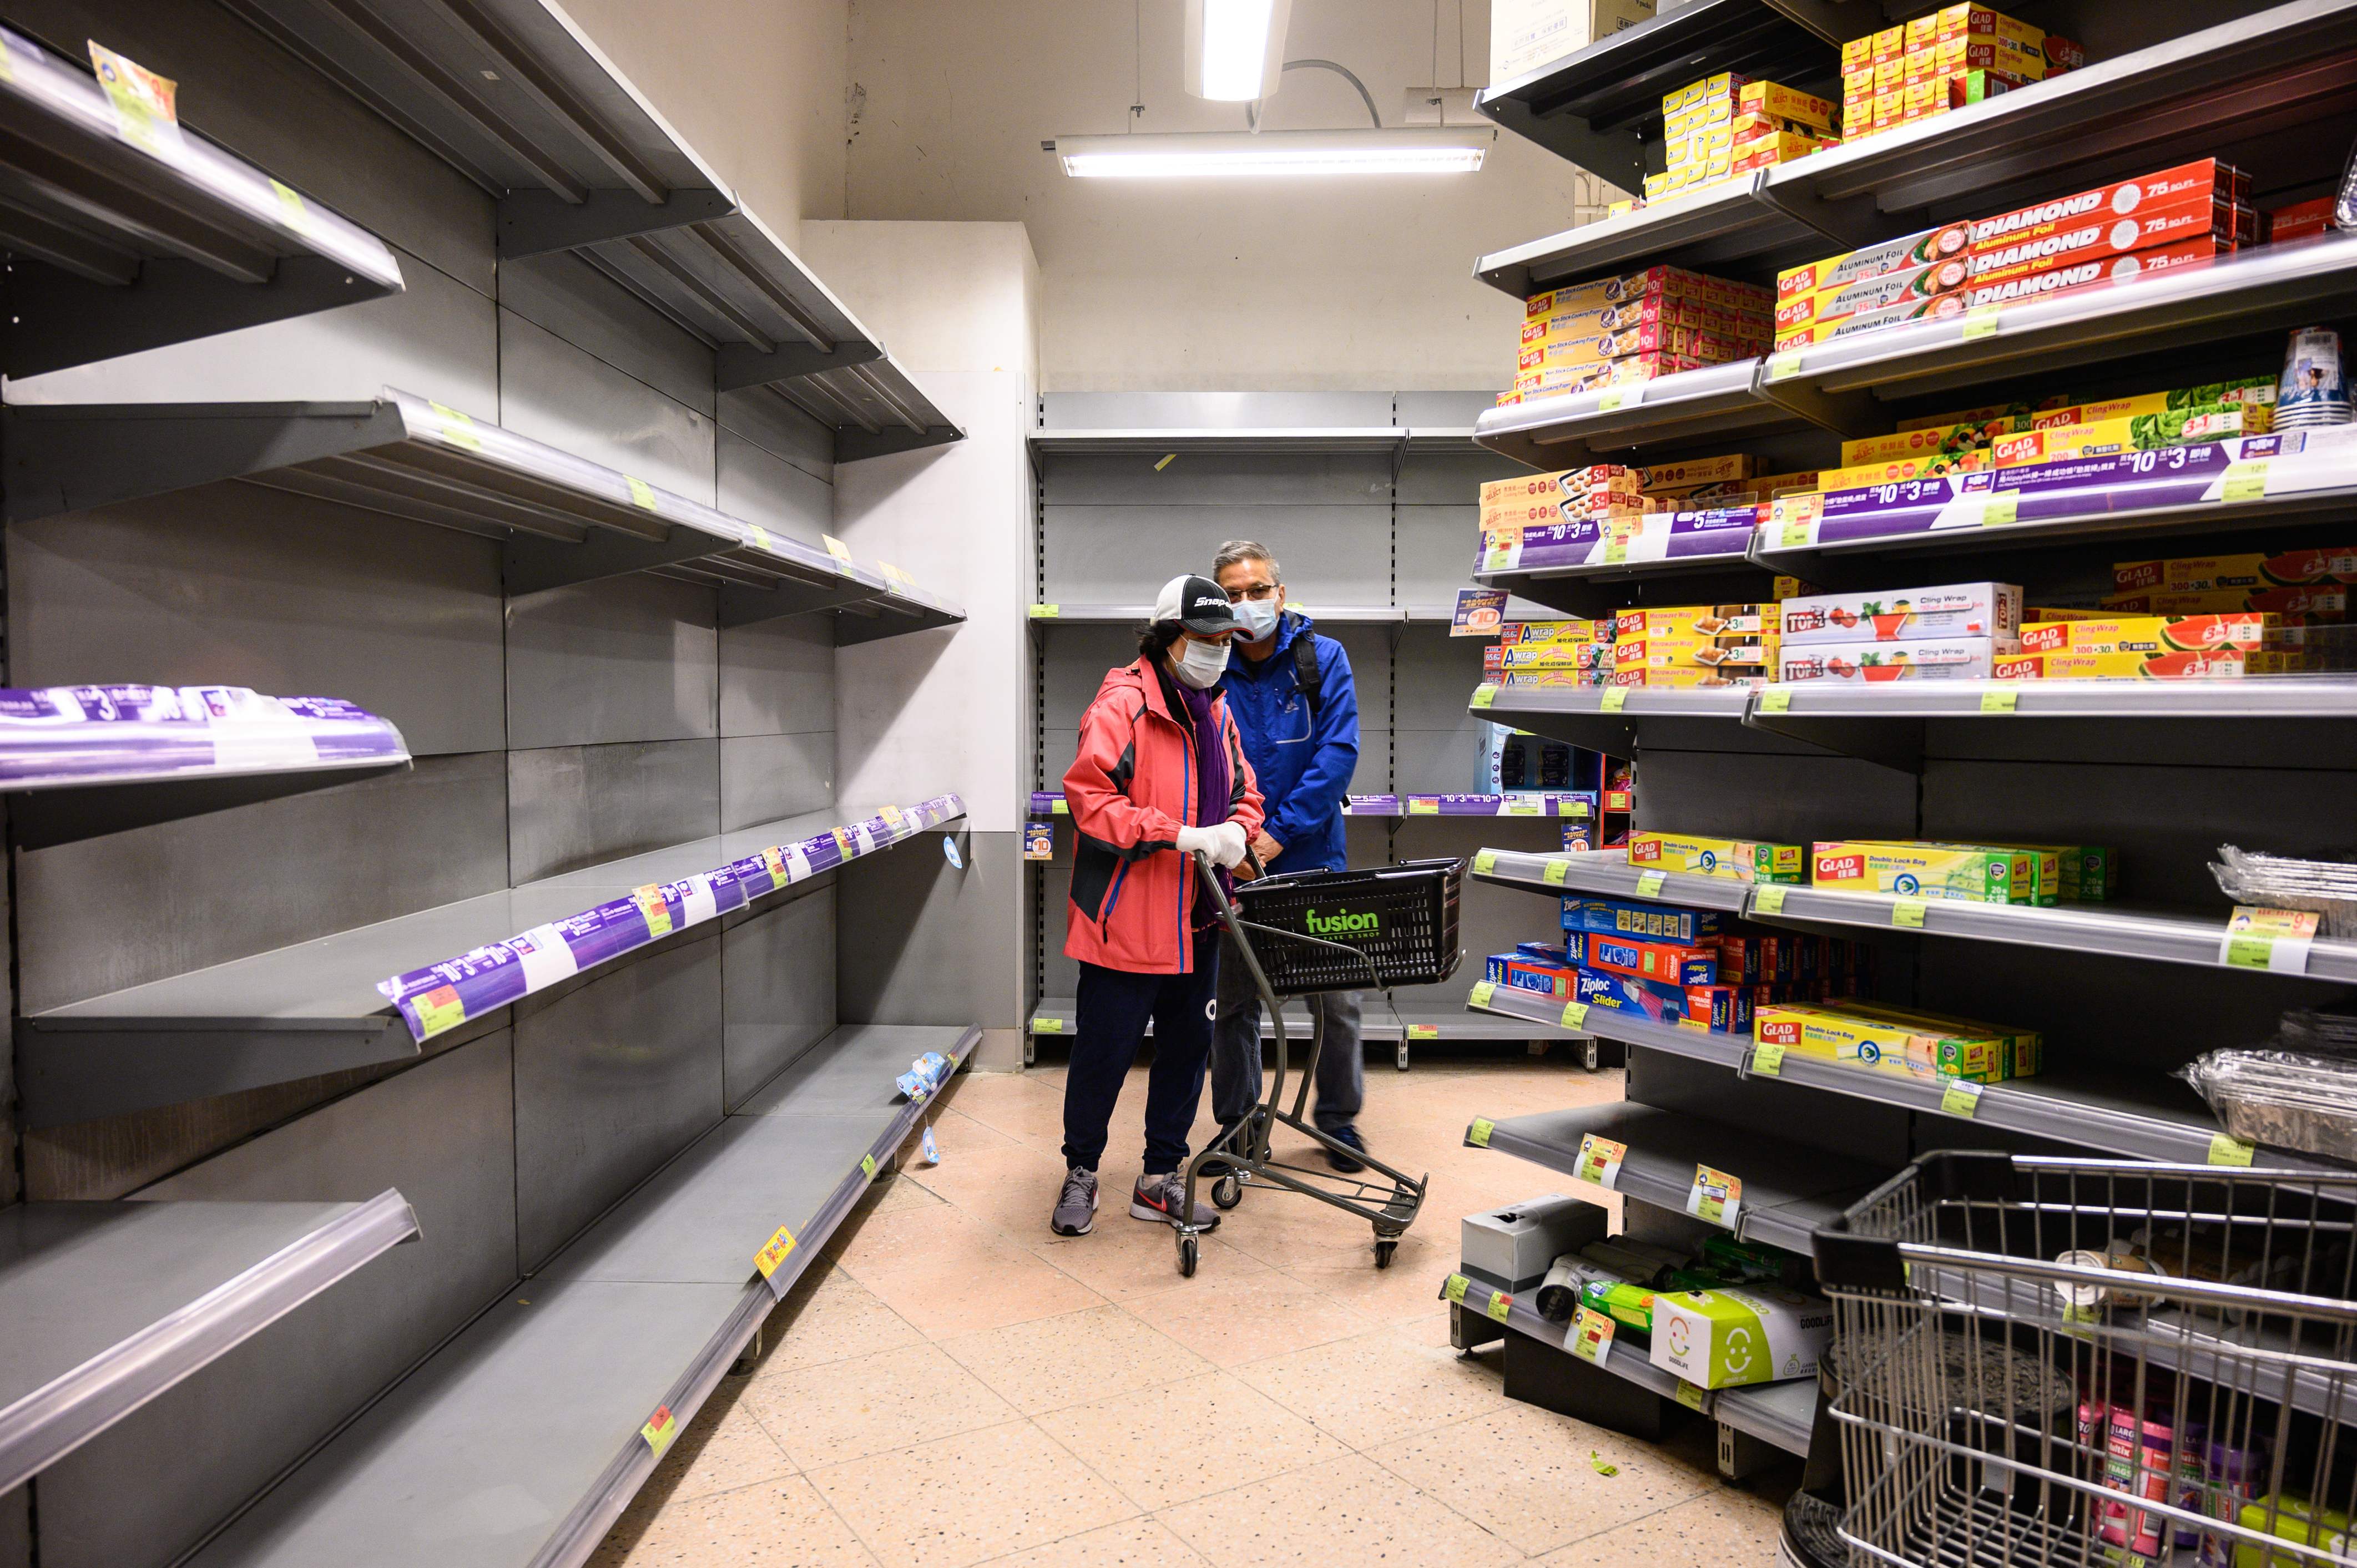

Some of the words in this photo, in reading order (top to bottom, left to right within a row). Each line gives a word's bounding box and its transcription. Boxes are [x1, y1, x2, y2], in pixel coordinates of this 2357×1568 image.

[1970, 12, 1991, 24] GLAD
[1969, 44, 1989, 57] GLAD
[1773, 95, 1788, 104] SELECT
[1786, 144, 1803, 153] SELECT
[2147, 180, 2168, 196] 75
[1975, 192, 2103, 240] DIAMOND
[2145, 217, 2167, 233] 75
[1975, 229, 2030, 251] Aluminum
[2032, 223, 2055, 237] Foil
[1975, 227, 2101, 273] DIAMOND
[1838, 255, 1883, 272] ALUMINUM
[1886, 249, 1904, 260] FOIL
[2147, 255, 2168, 270] 75
[1974, 264, 2030, 284] Aluminum
[2031, 257, 2053, 271] Foil
[1576, 284, 1592, 294] Cooking
[1593, 281, 1608, 290] Paper
[1781, 271, 1809, 291] GLAD
[1972, 264, 2101, 306] DIAMOND
[1836, 287, 1882, 304] ALUMINUM
[1885, 281, 1903, 292] FOIL
[1528, 299, 1547, 312] GLAD
[1778, 302, 1806, 322] GLAD
[1572, 311, 1588, 321] Cooking
[1589, 308, 1602, 317] Paper
[1523, 326, 1542, 338] GLAD
[1835, 319, 1881, 336] ALUMINUM
[1883, 315, 1901, 326] FOIL
[1568, 338, 1584, 347] Cooking
[1586, 336, 1599, 344] Paper
[1778, 334, 1806, 352] GLAD
[1521, 352, 1538, 365] GLAD
[1566, 365, 1583, 373] Cooking
[1516, 380, 1535, 390] GLAD
[2015, 419, 2031, 429] 300
[2035, 413, 2071, 429] GLAD
[1997, 438, 2033, 458] GLAD
[1485, 488, 1502, 501] SELECT
[2117, 565, 2153, 584] GLAD
[1618, 615, 1640, 628] GLAD
[2022, 628, 2058, 645] GLAD
[1618, 644, 1640, 657] GLAD
[1997, 658, 2033, 677] GLAD
[1617, 671, 1639, 684] GLAD
[1034, 840, 1048, 850] $10
[1634, 843, 1655, 854] GLAD
[1819, 858, 1855, 873] GLAD
[1563, 899, 1581, 912] Ziploc
[1306, 908, 1378, 933] fusion
[1701, 913, 1717, 924] Ziploc
[1689, 973, 1708, 984] Ziploc
[1581, 977, 1610, 995] Ziploc
[1593, 993, 1622, 1009] Slider
[1687, 995, 1710, 1004] STORAGE
[1763, 1023, 1793, 1035] GLAD
[1805, 1025, 1825, 1034] Double
